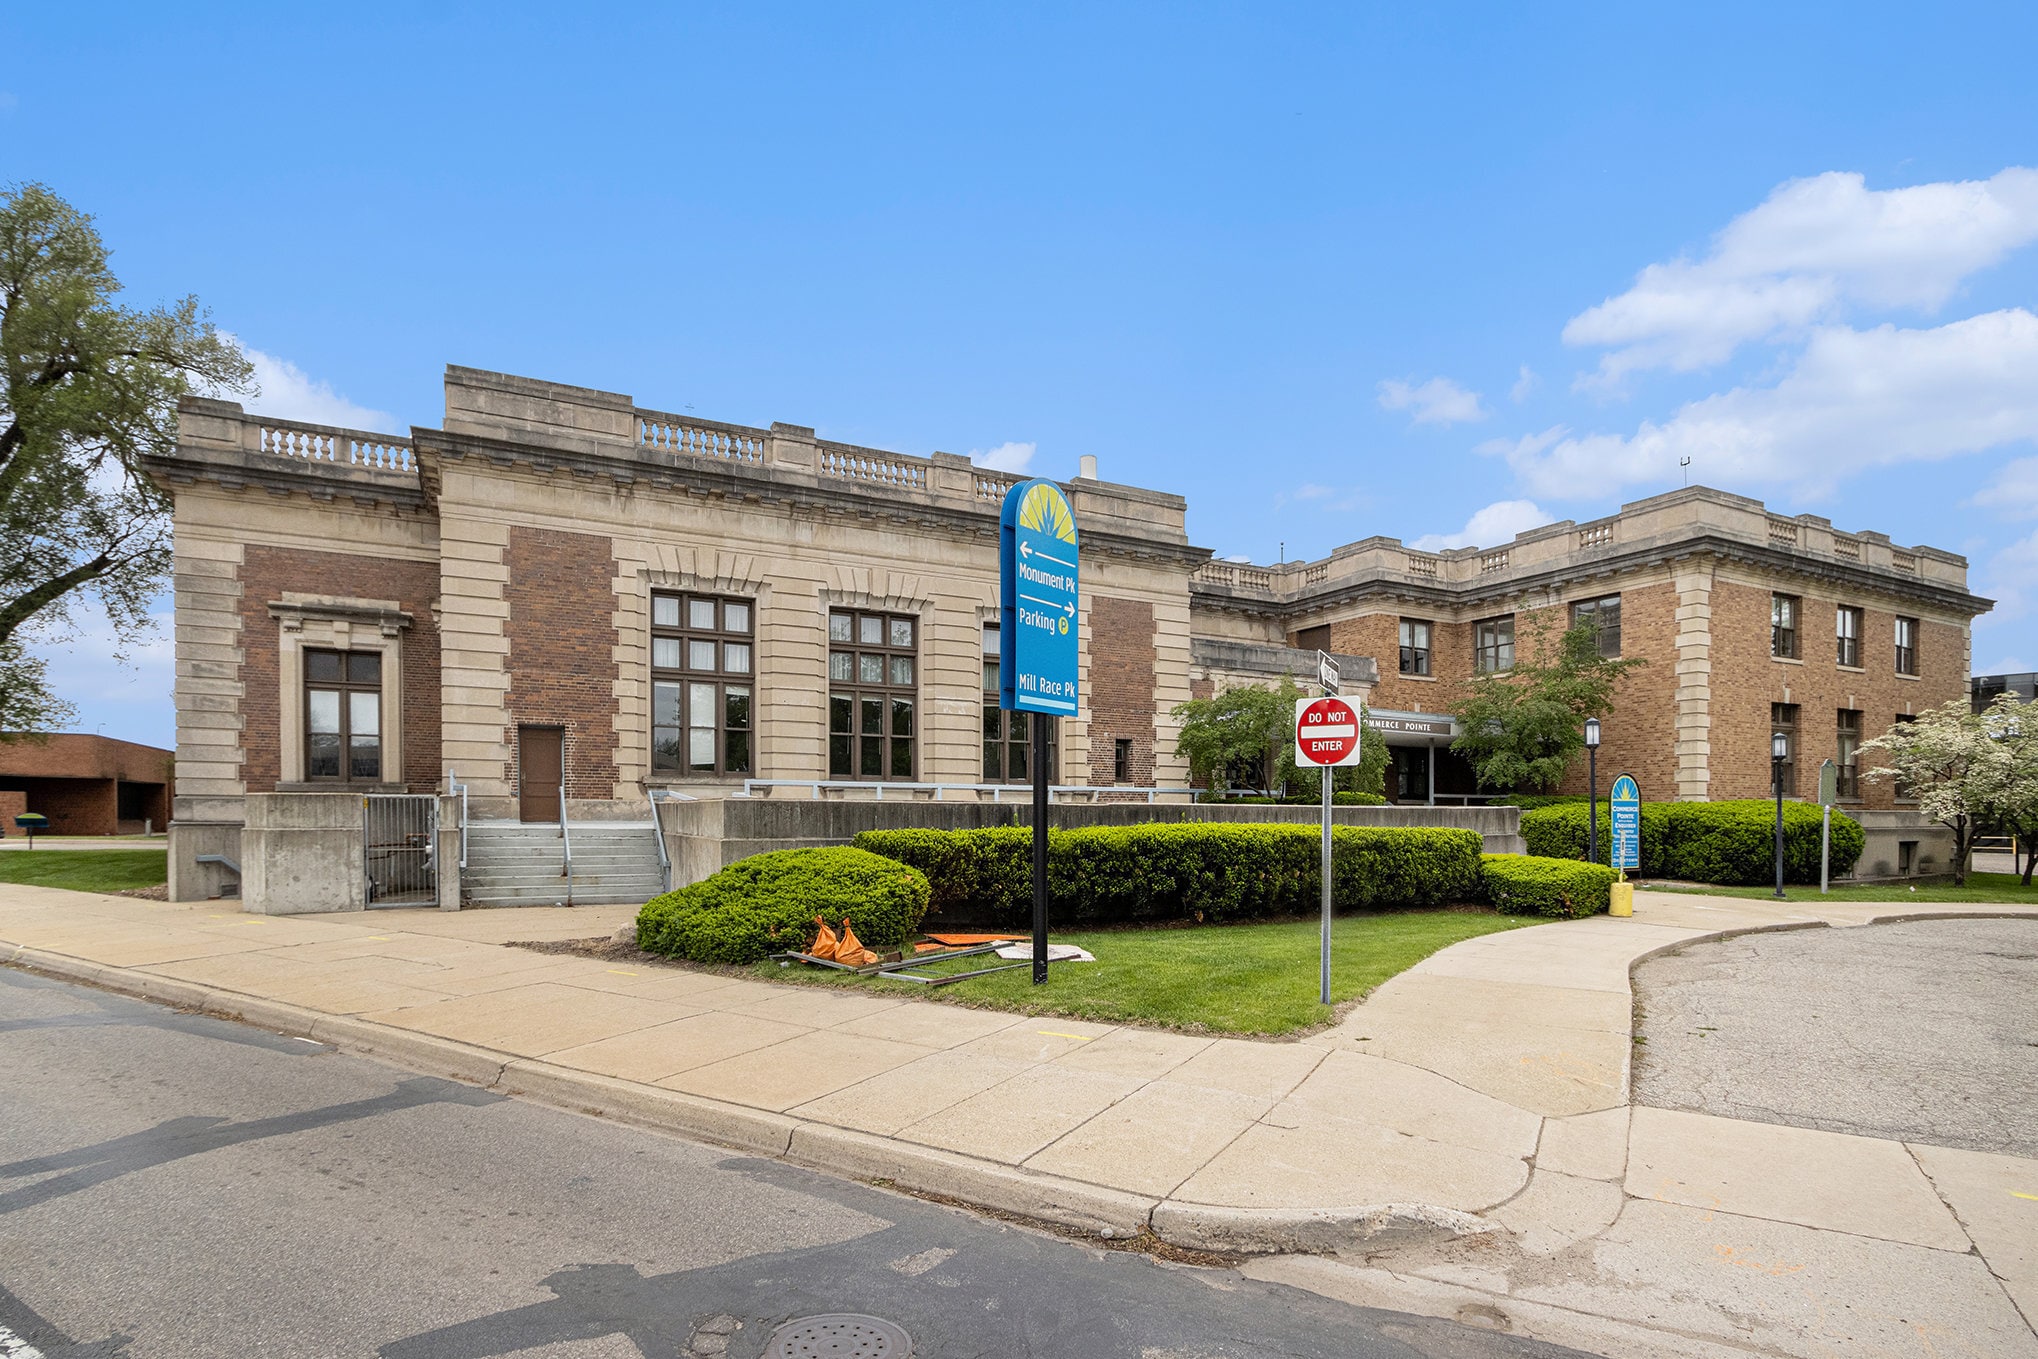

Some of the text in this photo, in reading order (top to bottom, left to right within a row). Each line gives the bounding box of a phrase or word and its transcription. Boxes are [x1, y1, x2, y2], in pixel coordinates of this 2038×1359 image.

[1019, 562, 1076, 594] Monument Pk
[1019, 607, 1055, 636] Parking
[1019, 673, 1075, 698] Mill Race Pk
[1308, 711, 1347, 723] DO NOT
[1363, 719, 1431, 732] OMMERCE POINTE
[1312, 741, 1343, 752] ENTER
